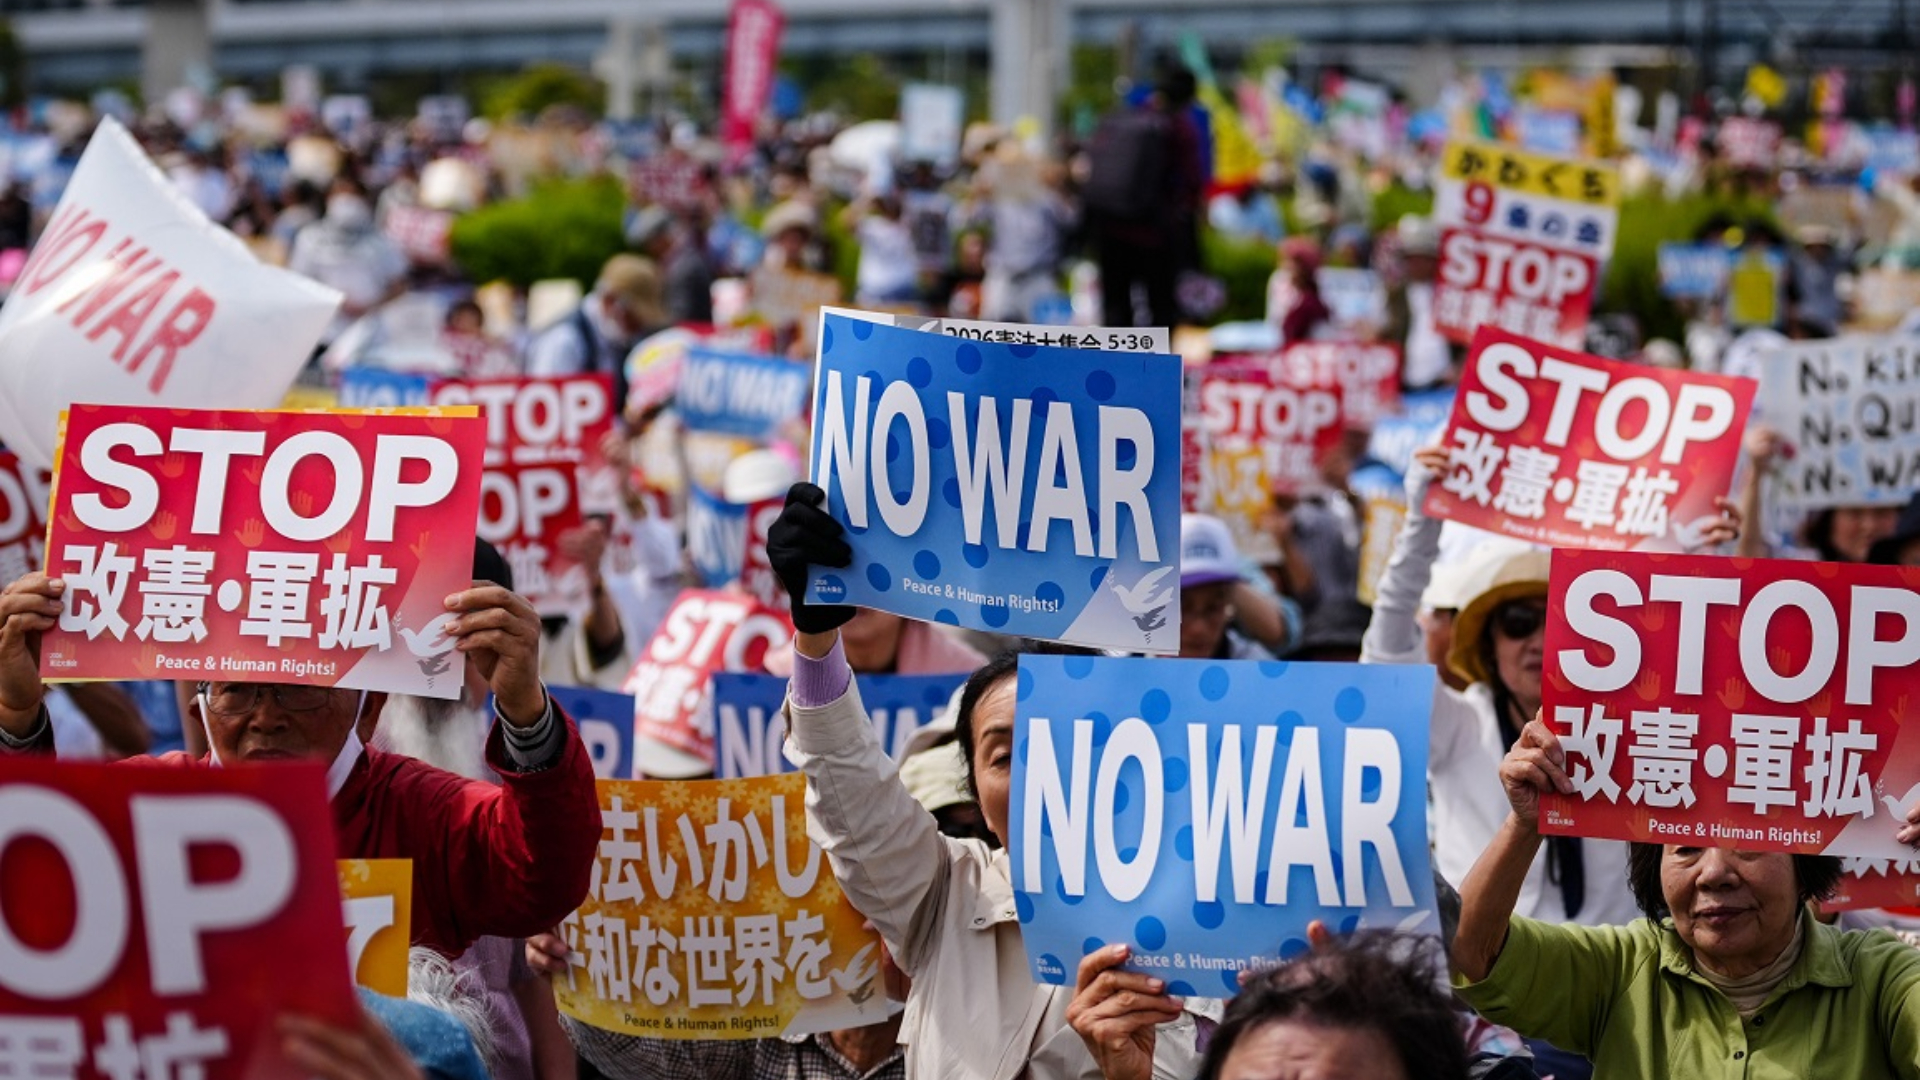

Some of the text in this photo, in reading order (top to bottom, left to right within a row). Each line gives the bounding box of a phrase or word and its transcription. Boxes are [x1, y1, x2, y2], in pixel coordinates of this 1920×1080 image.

[54, 236, 217, 395] WAR
[1441, 232, 1589, 306] STOP
[1203, 380, 1338, 439] STOP
[1466, 342, 1736, 465] STOP
[70, 422, 459, 543] STOP
[818, 369, 930, 537] NO
[946, 391, 1161, 562] WAR
[60, 541, 398, 652] 改憲・軍拡
[903, 578, 1060, 613] Peace & Human Rights!
[1558, 568, 1920, 706] STOP
[155, 653, 336, 677] Peace & Human Rights!
[1023, 717, 1416, 908] NO WAR
[1554, 702, 1879, 820] 改憲・軍拡
[1648, 818, 1822, 846] Peace & Human Rights!
[1173, 953, 1187, 968] &
[1189, 954, 1247, 972] Human
[624, 1012, 779, 1031] Peace & Human Rights!
